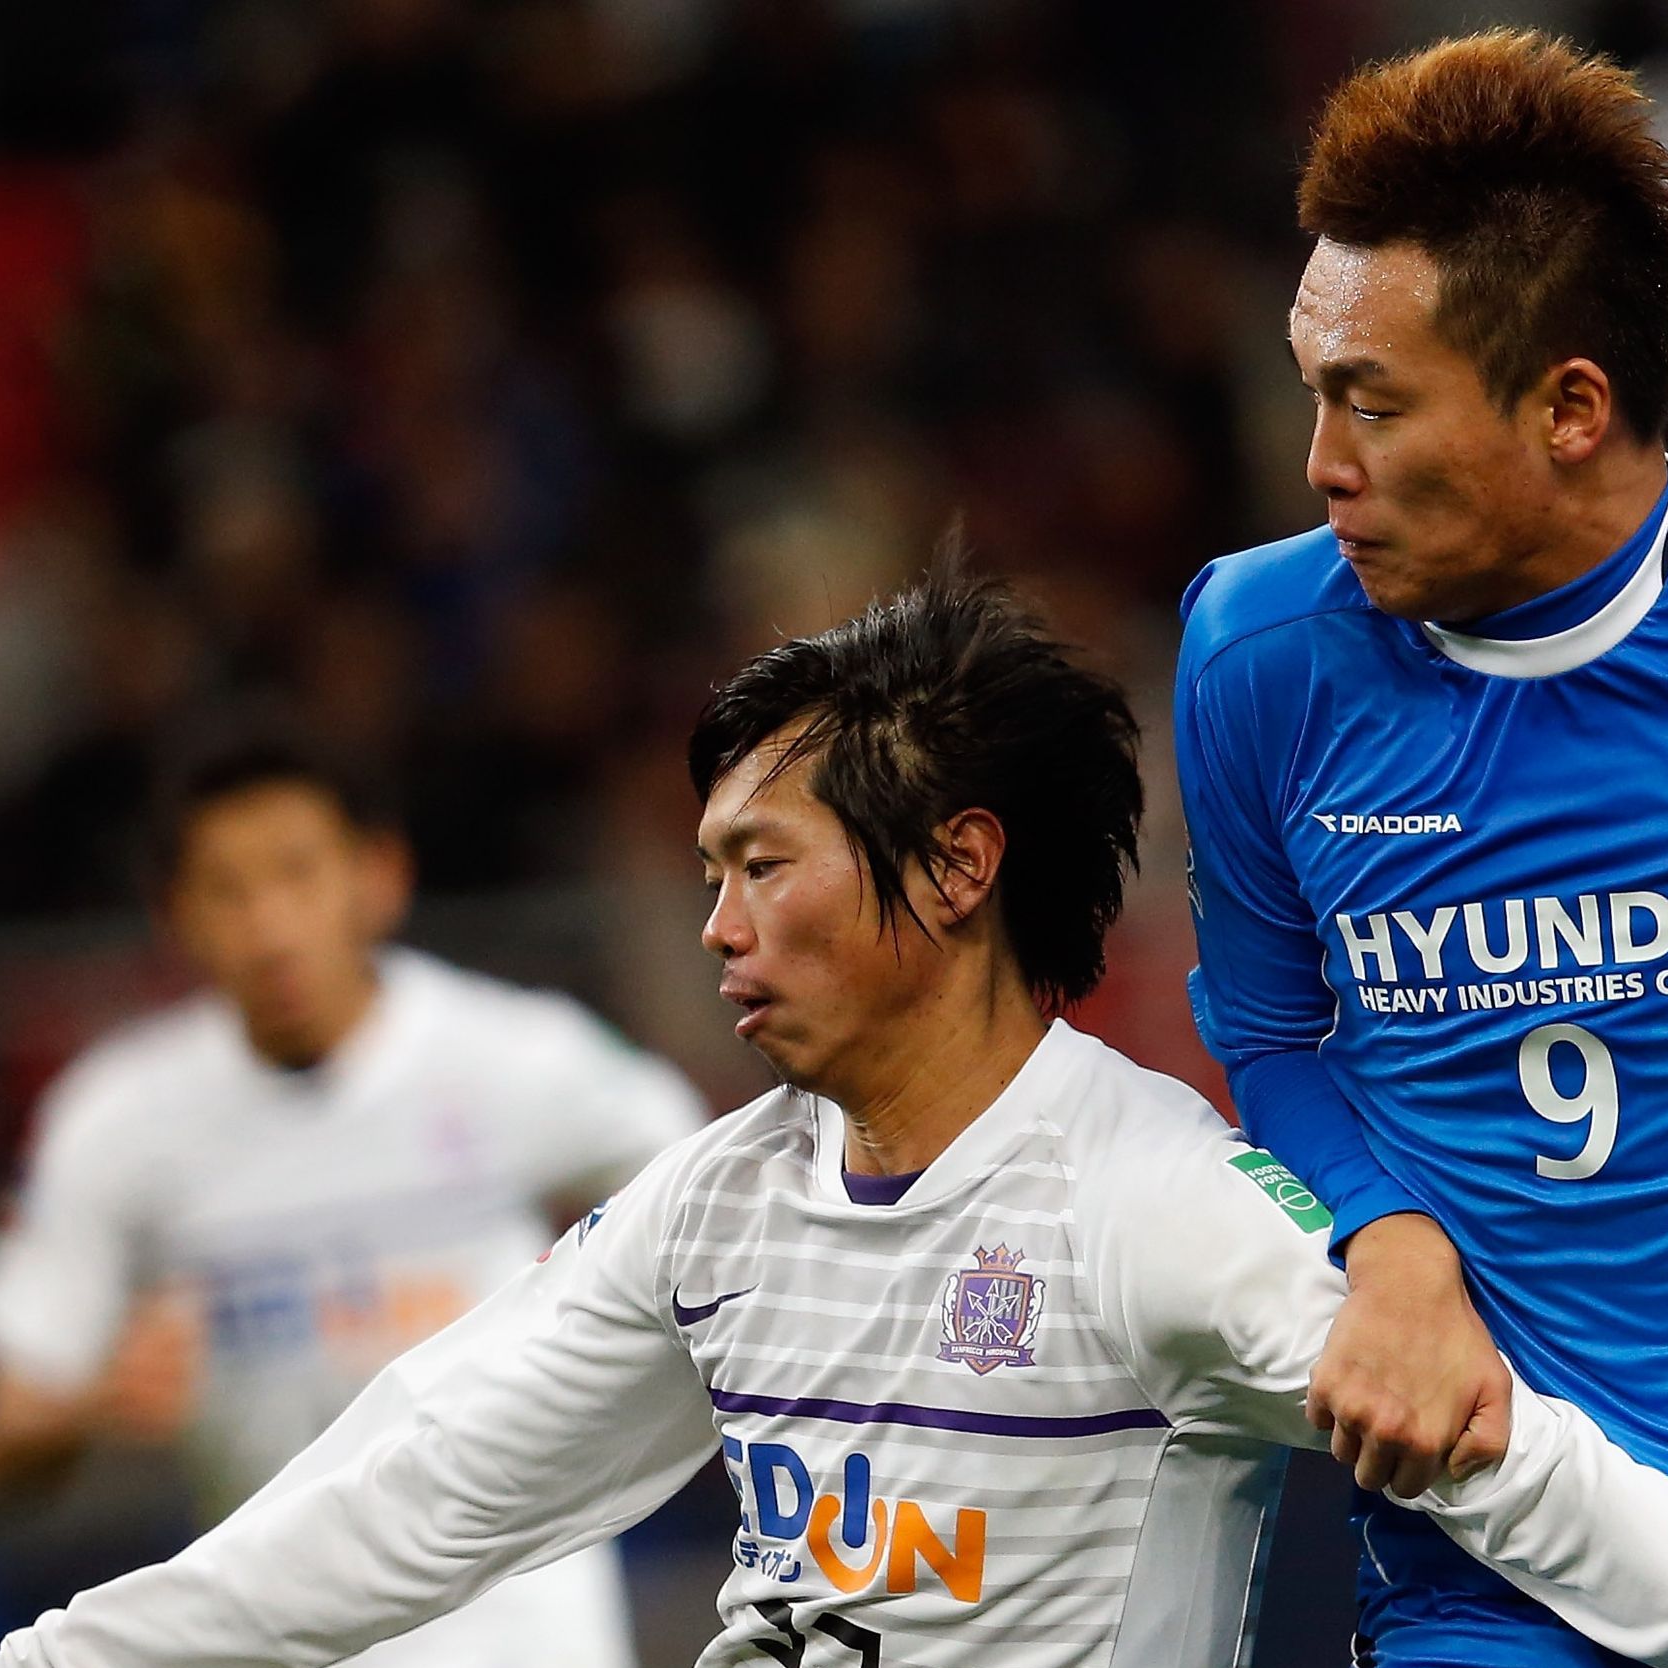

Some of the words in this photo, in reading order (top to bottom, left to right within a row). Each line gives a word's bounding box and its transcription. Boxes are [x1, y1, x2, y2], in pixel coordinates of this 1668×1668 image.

[1341, 814, 1463, 834] DIADORA
[1358, 984, 1448, 1013] HEAVY
[1457, 972, 1645, 1011] INDUSTRIES
[1518, 1023, 1619, 1180] 9
